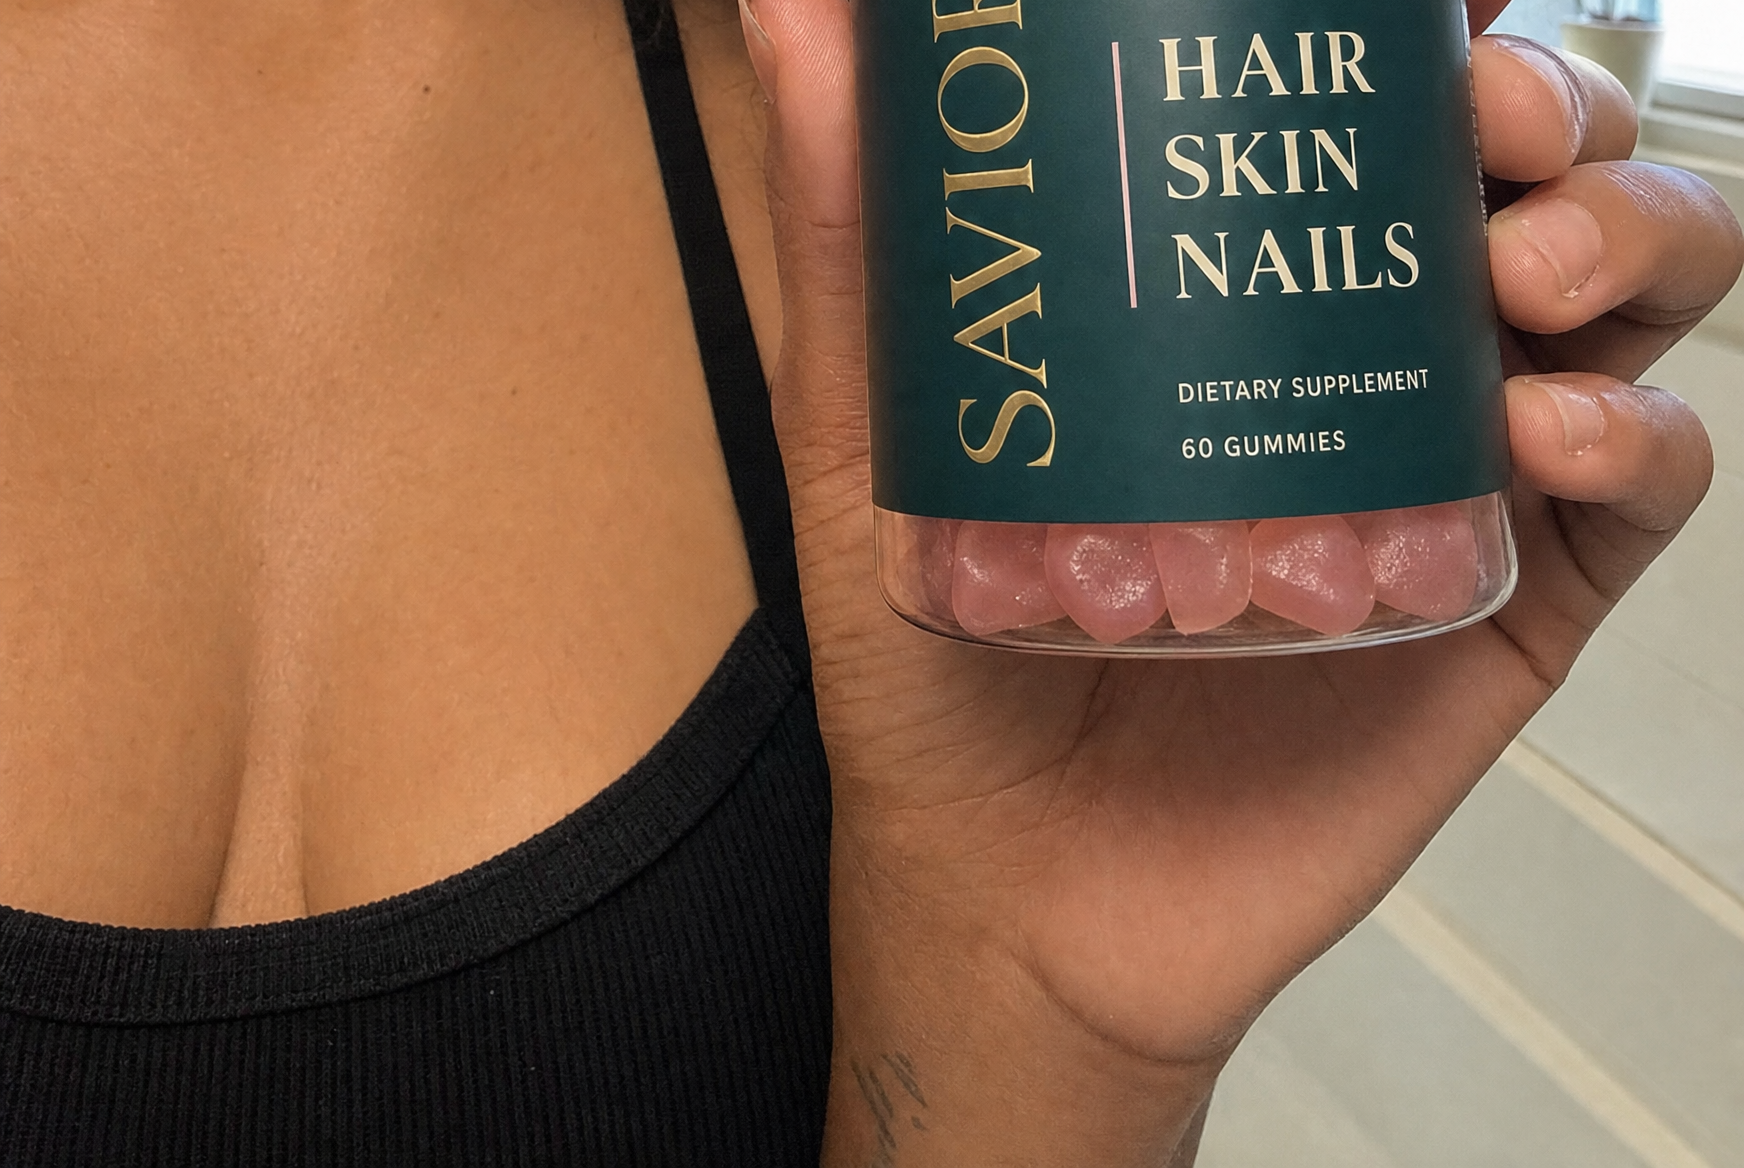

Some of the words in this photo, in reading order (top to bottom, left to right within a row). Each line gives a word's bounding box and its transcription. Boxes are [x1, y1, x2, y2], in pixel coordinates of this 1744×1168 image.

[1158, 31, 1376, 102] HAIR
[1164, 127, 1359, 200] SKIN
[1170, 221, 1420, 299] NAILS
[1178, 378, 1282, 404] DIETARY
[1291, 368, 1429, 398] SUPPLEMENT
[1181, 437, 1213, 460] 60
[1223, 429, 1346, 458] GUMMIES
